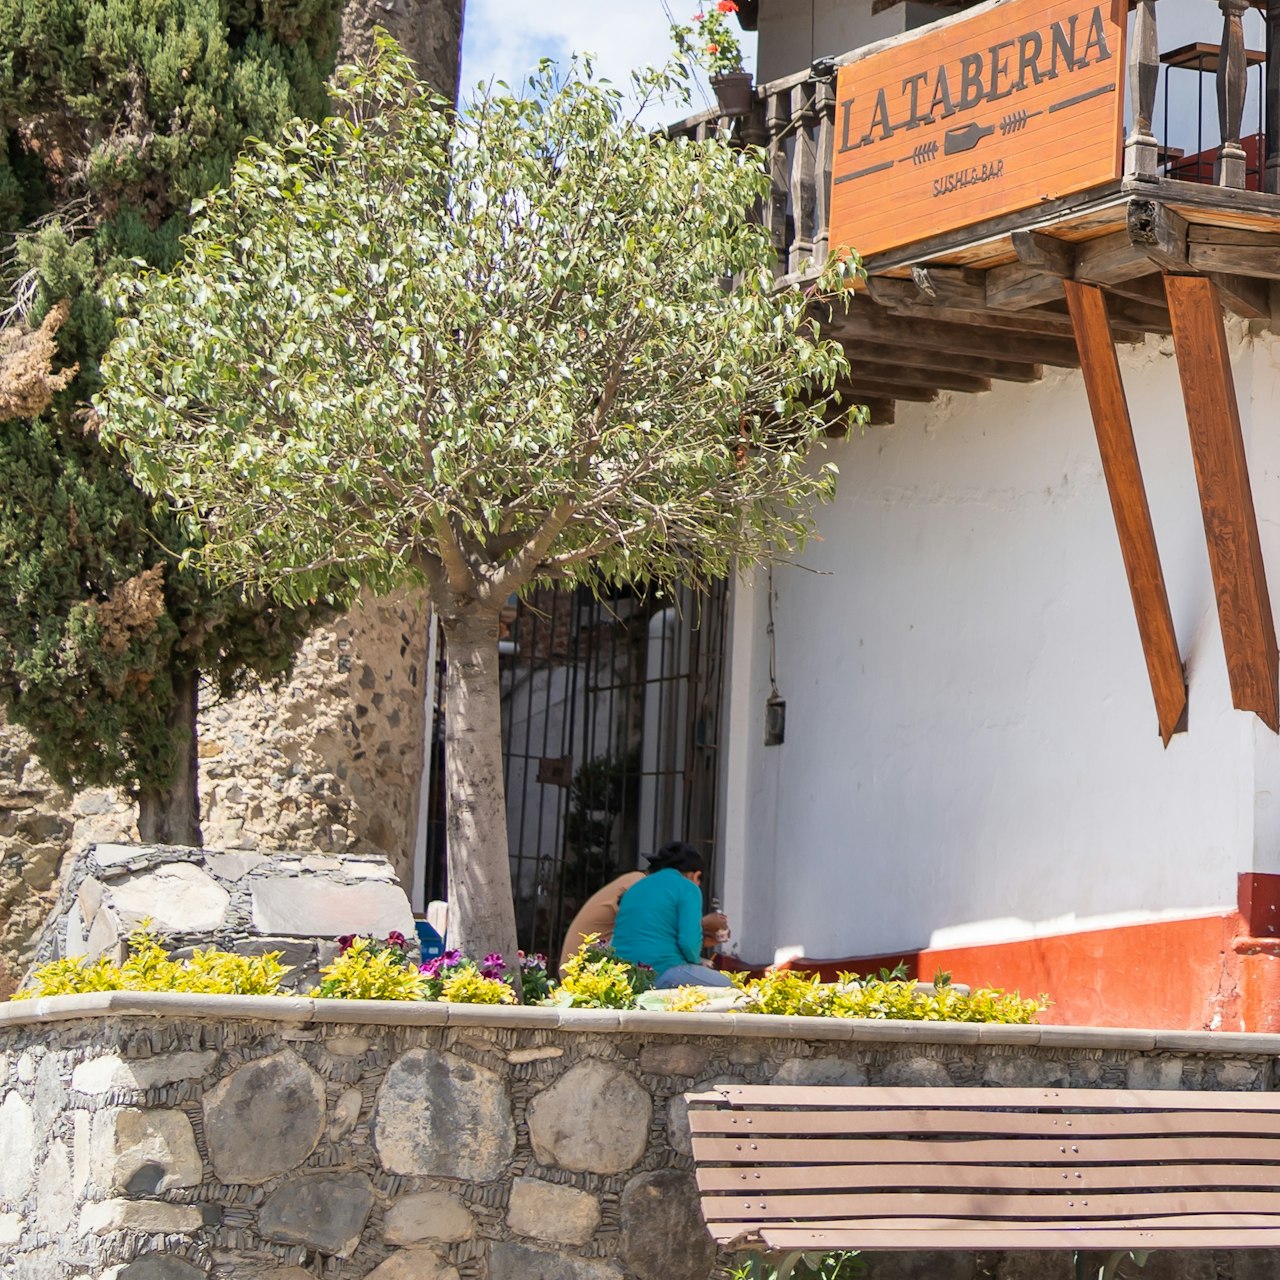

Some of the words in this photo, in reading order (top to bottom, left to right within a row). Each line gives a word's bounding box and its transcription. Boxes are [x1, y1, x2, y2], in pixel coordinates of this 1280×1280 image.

[837, 87, 894, 154] LA
[902, 6, 1112, 131] TABERNA
[933, 168, 968, 197] SUSHI
[981, 159, 1004, 182] BAR
